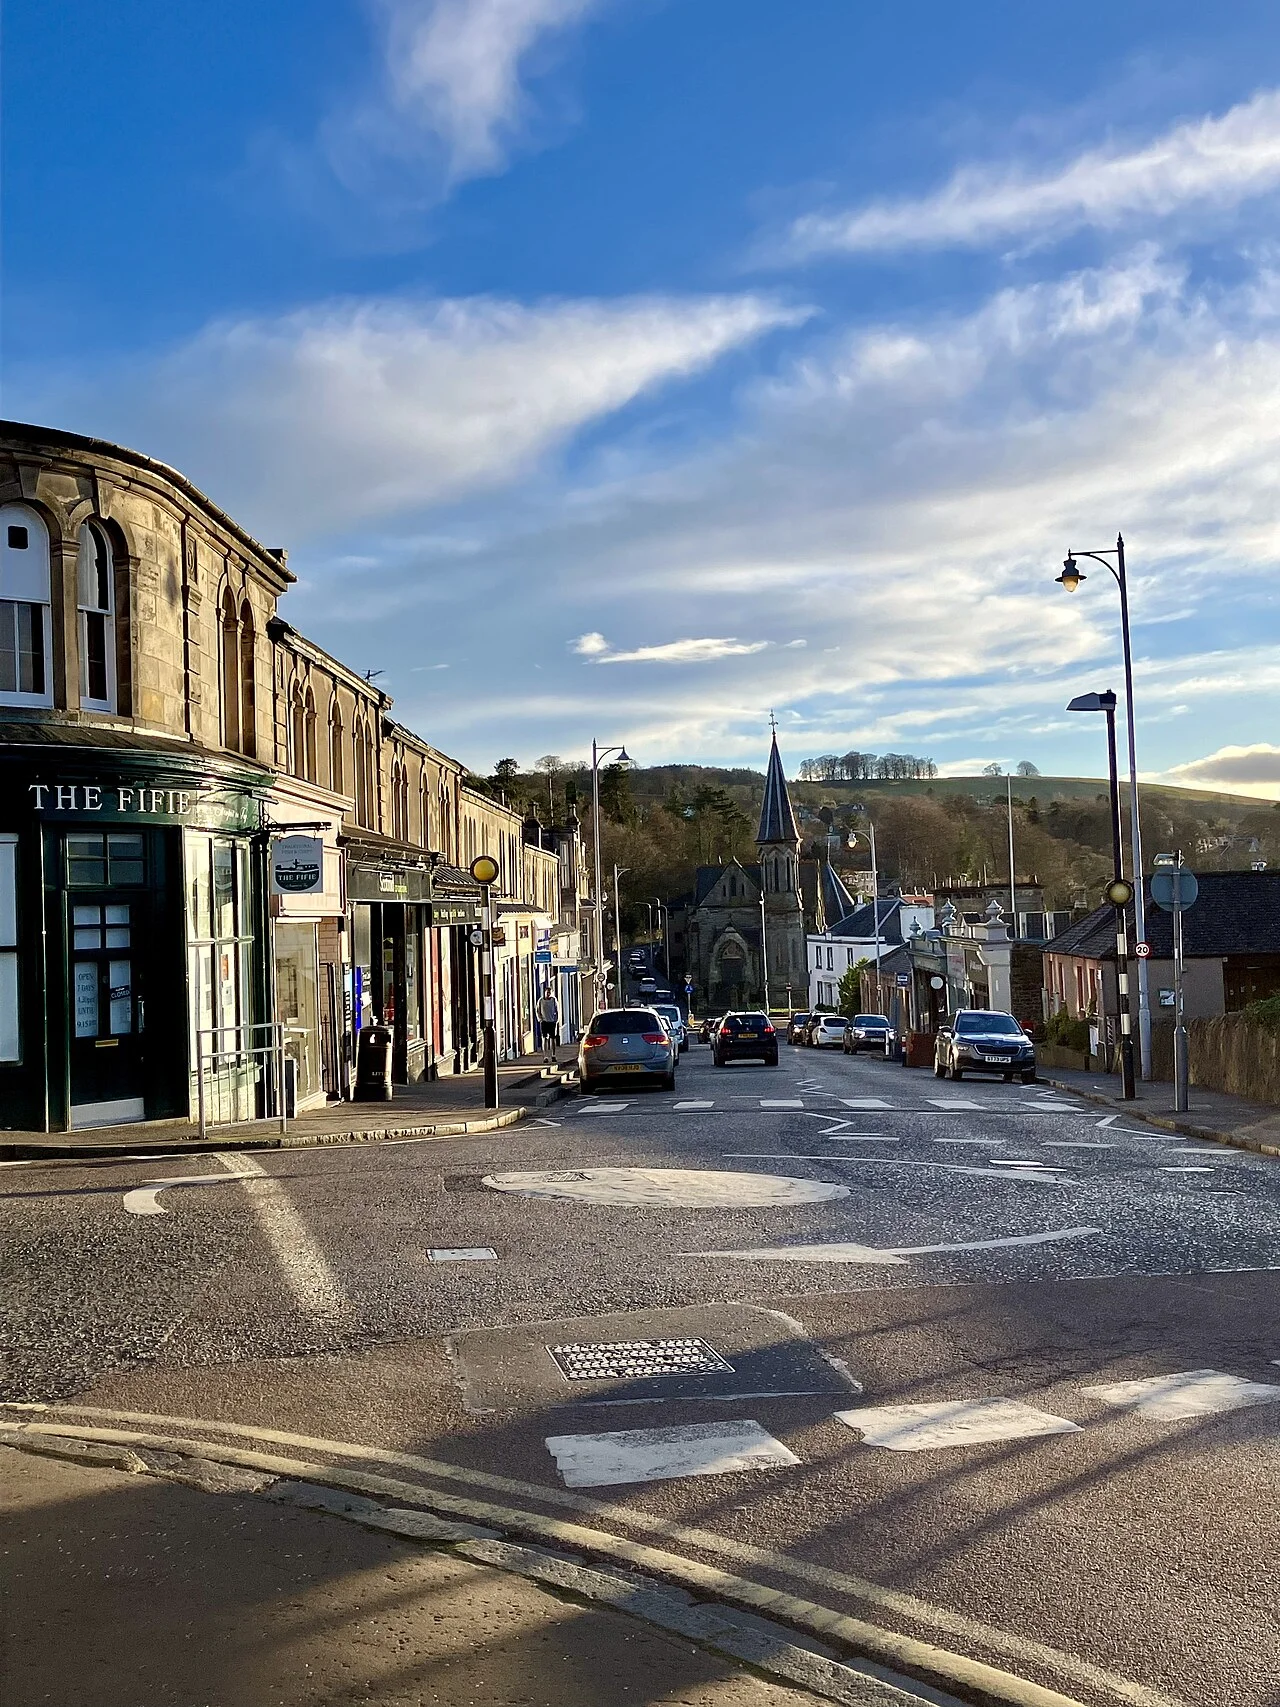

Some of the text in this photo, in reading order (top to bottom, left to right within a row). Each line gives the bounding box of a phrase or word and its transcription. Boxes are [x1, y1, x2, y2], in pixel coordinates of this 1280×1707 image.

[28, 784, 103, 810] THE
[117, 787, 191, 815] FIFIE
[1137, 946, 1148, 954] 20
[111, 989, 130, 999] CLOSED
